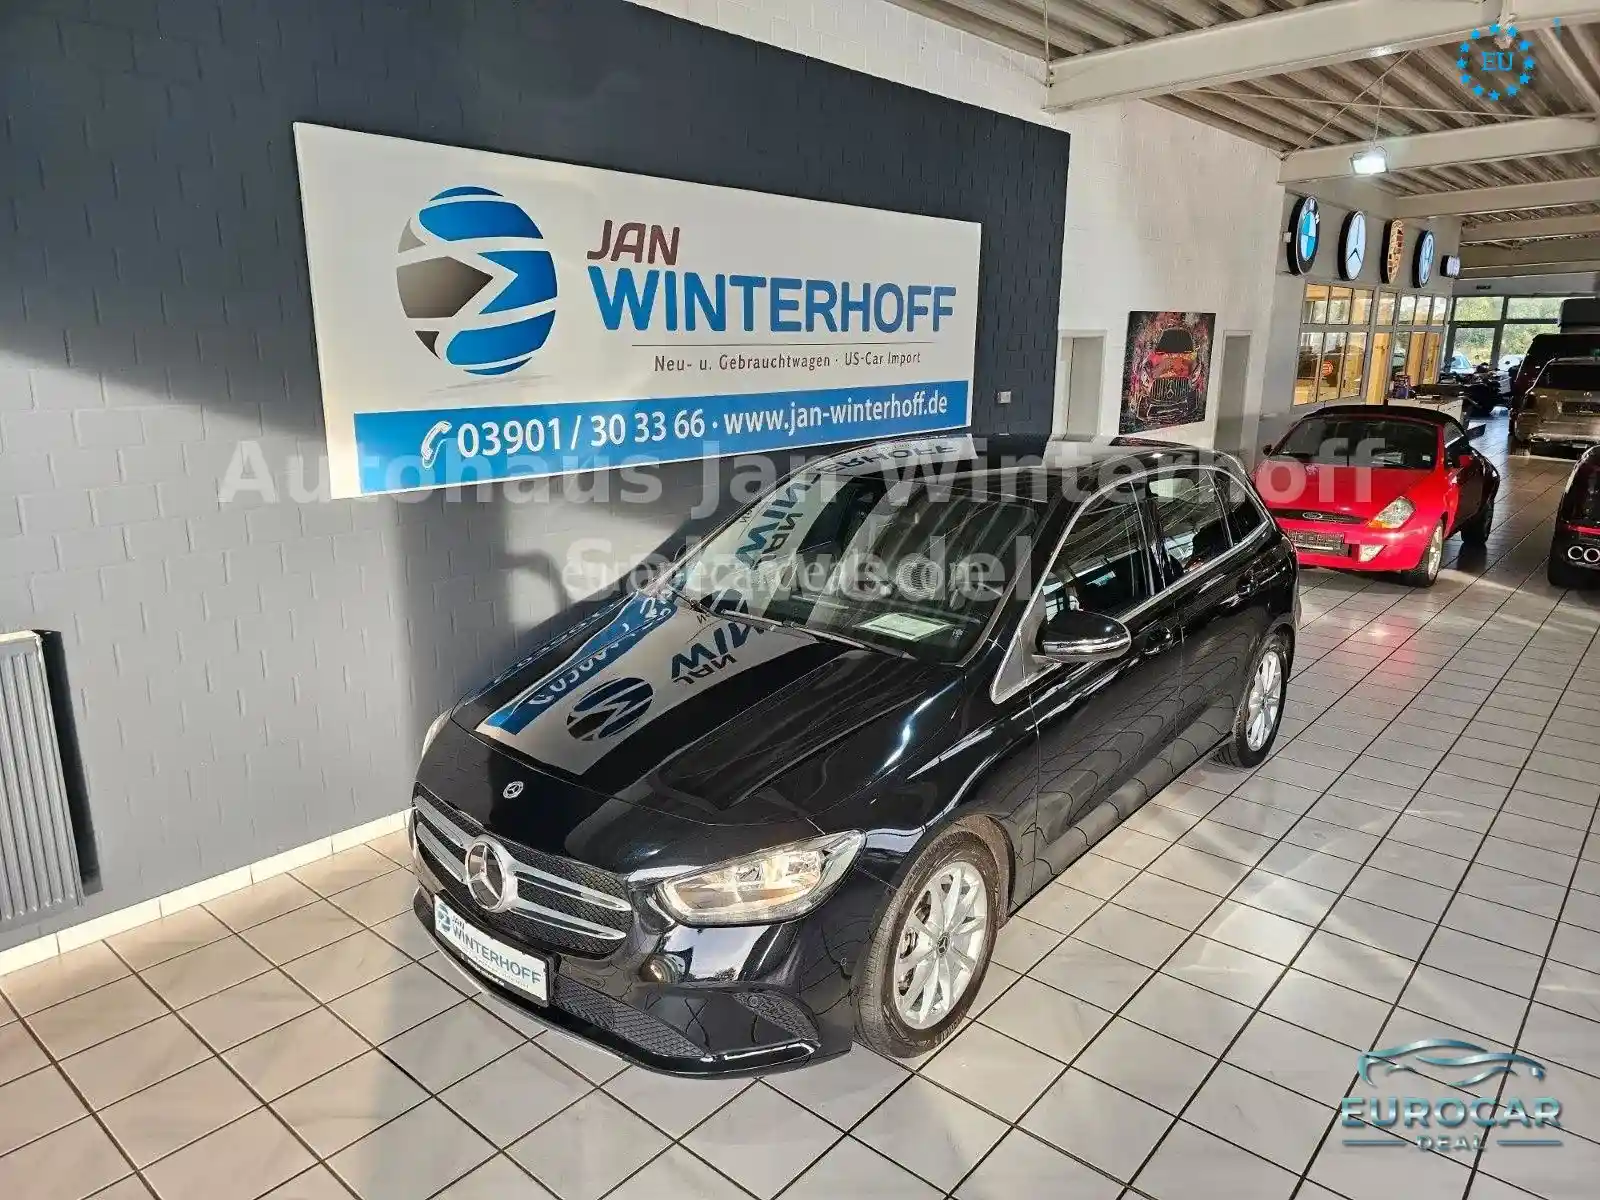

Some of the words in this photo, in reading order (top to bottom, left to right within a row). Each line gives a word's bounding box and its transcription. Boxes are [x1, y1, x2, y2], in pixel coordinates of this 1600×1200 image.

[586, 219, 681, 266] JAN
[586, 265, 957, 334] WINTERHOFF
[654, 354, 692, 372] Neu-
[699, 358, 712, 371] u.
[719, 353, 830, 371] Gebrauchtwagen
[845, 351, 883, 367] US-Car
[888, 351, 921, 369] Import
[457, 417, 561, 458] 03901
[591, 413, 626, 448] 30
[634, 411, 667, 443] 33
[674, 408, 706, 440] 66
[723, 389, 948, 437] www.jan-winterhoff.de
[452, 921, 542, 984] WINTERHOFF
